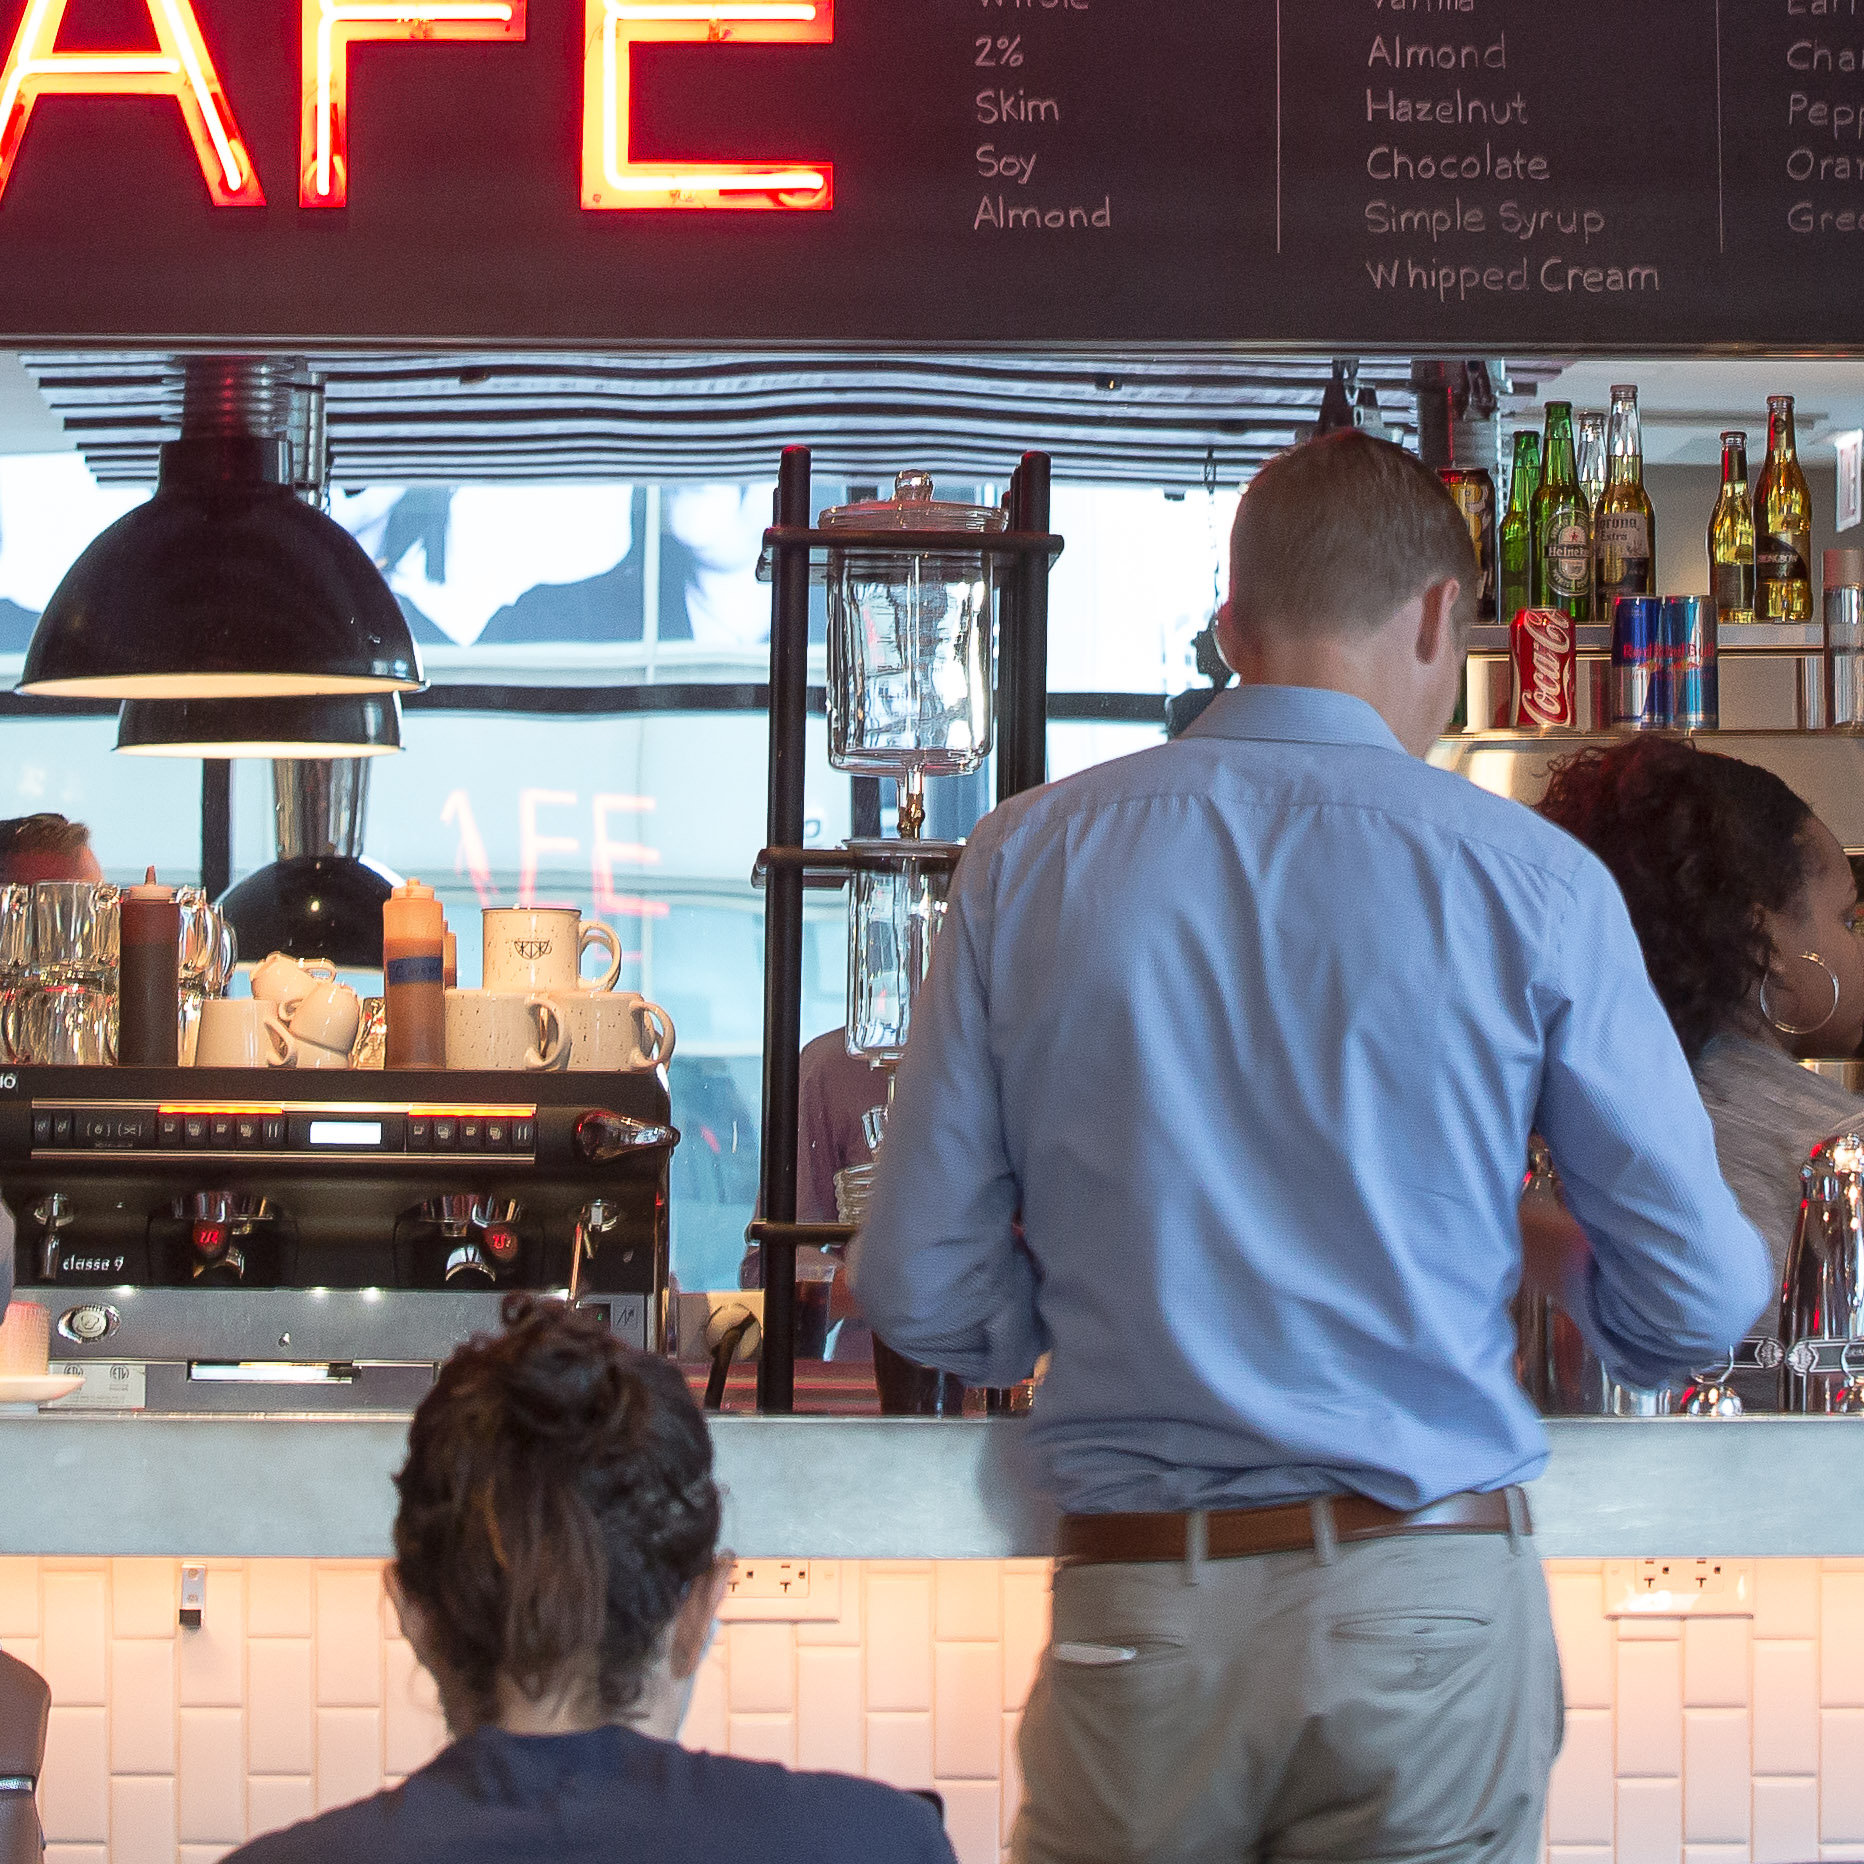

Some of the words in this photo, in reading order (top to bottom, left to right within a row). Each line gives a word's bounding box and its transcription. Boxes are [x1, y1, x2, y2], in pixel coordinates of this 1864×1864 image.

[975, 35, 1023, 67] 2%
[1368, 33, 1506, 69] Almond
[976, 89, 1059, 124] Skim
[1366, 88, 1527, 124] Hazelnut
[976, 144, 1036, 184] Soy
[1367, 142, 1549, 180] Chocolate
[974, 196, 1110, 230] Almond
[1365, 197, 1485, 242] Simple
[1499, 201, 1605, 244] Syrup
[1366, 257, 1529, 302] Whipped
[1540, 257, 1659, 292] Cream
